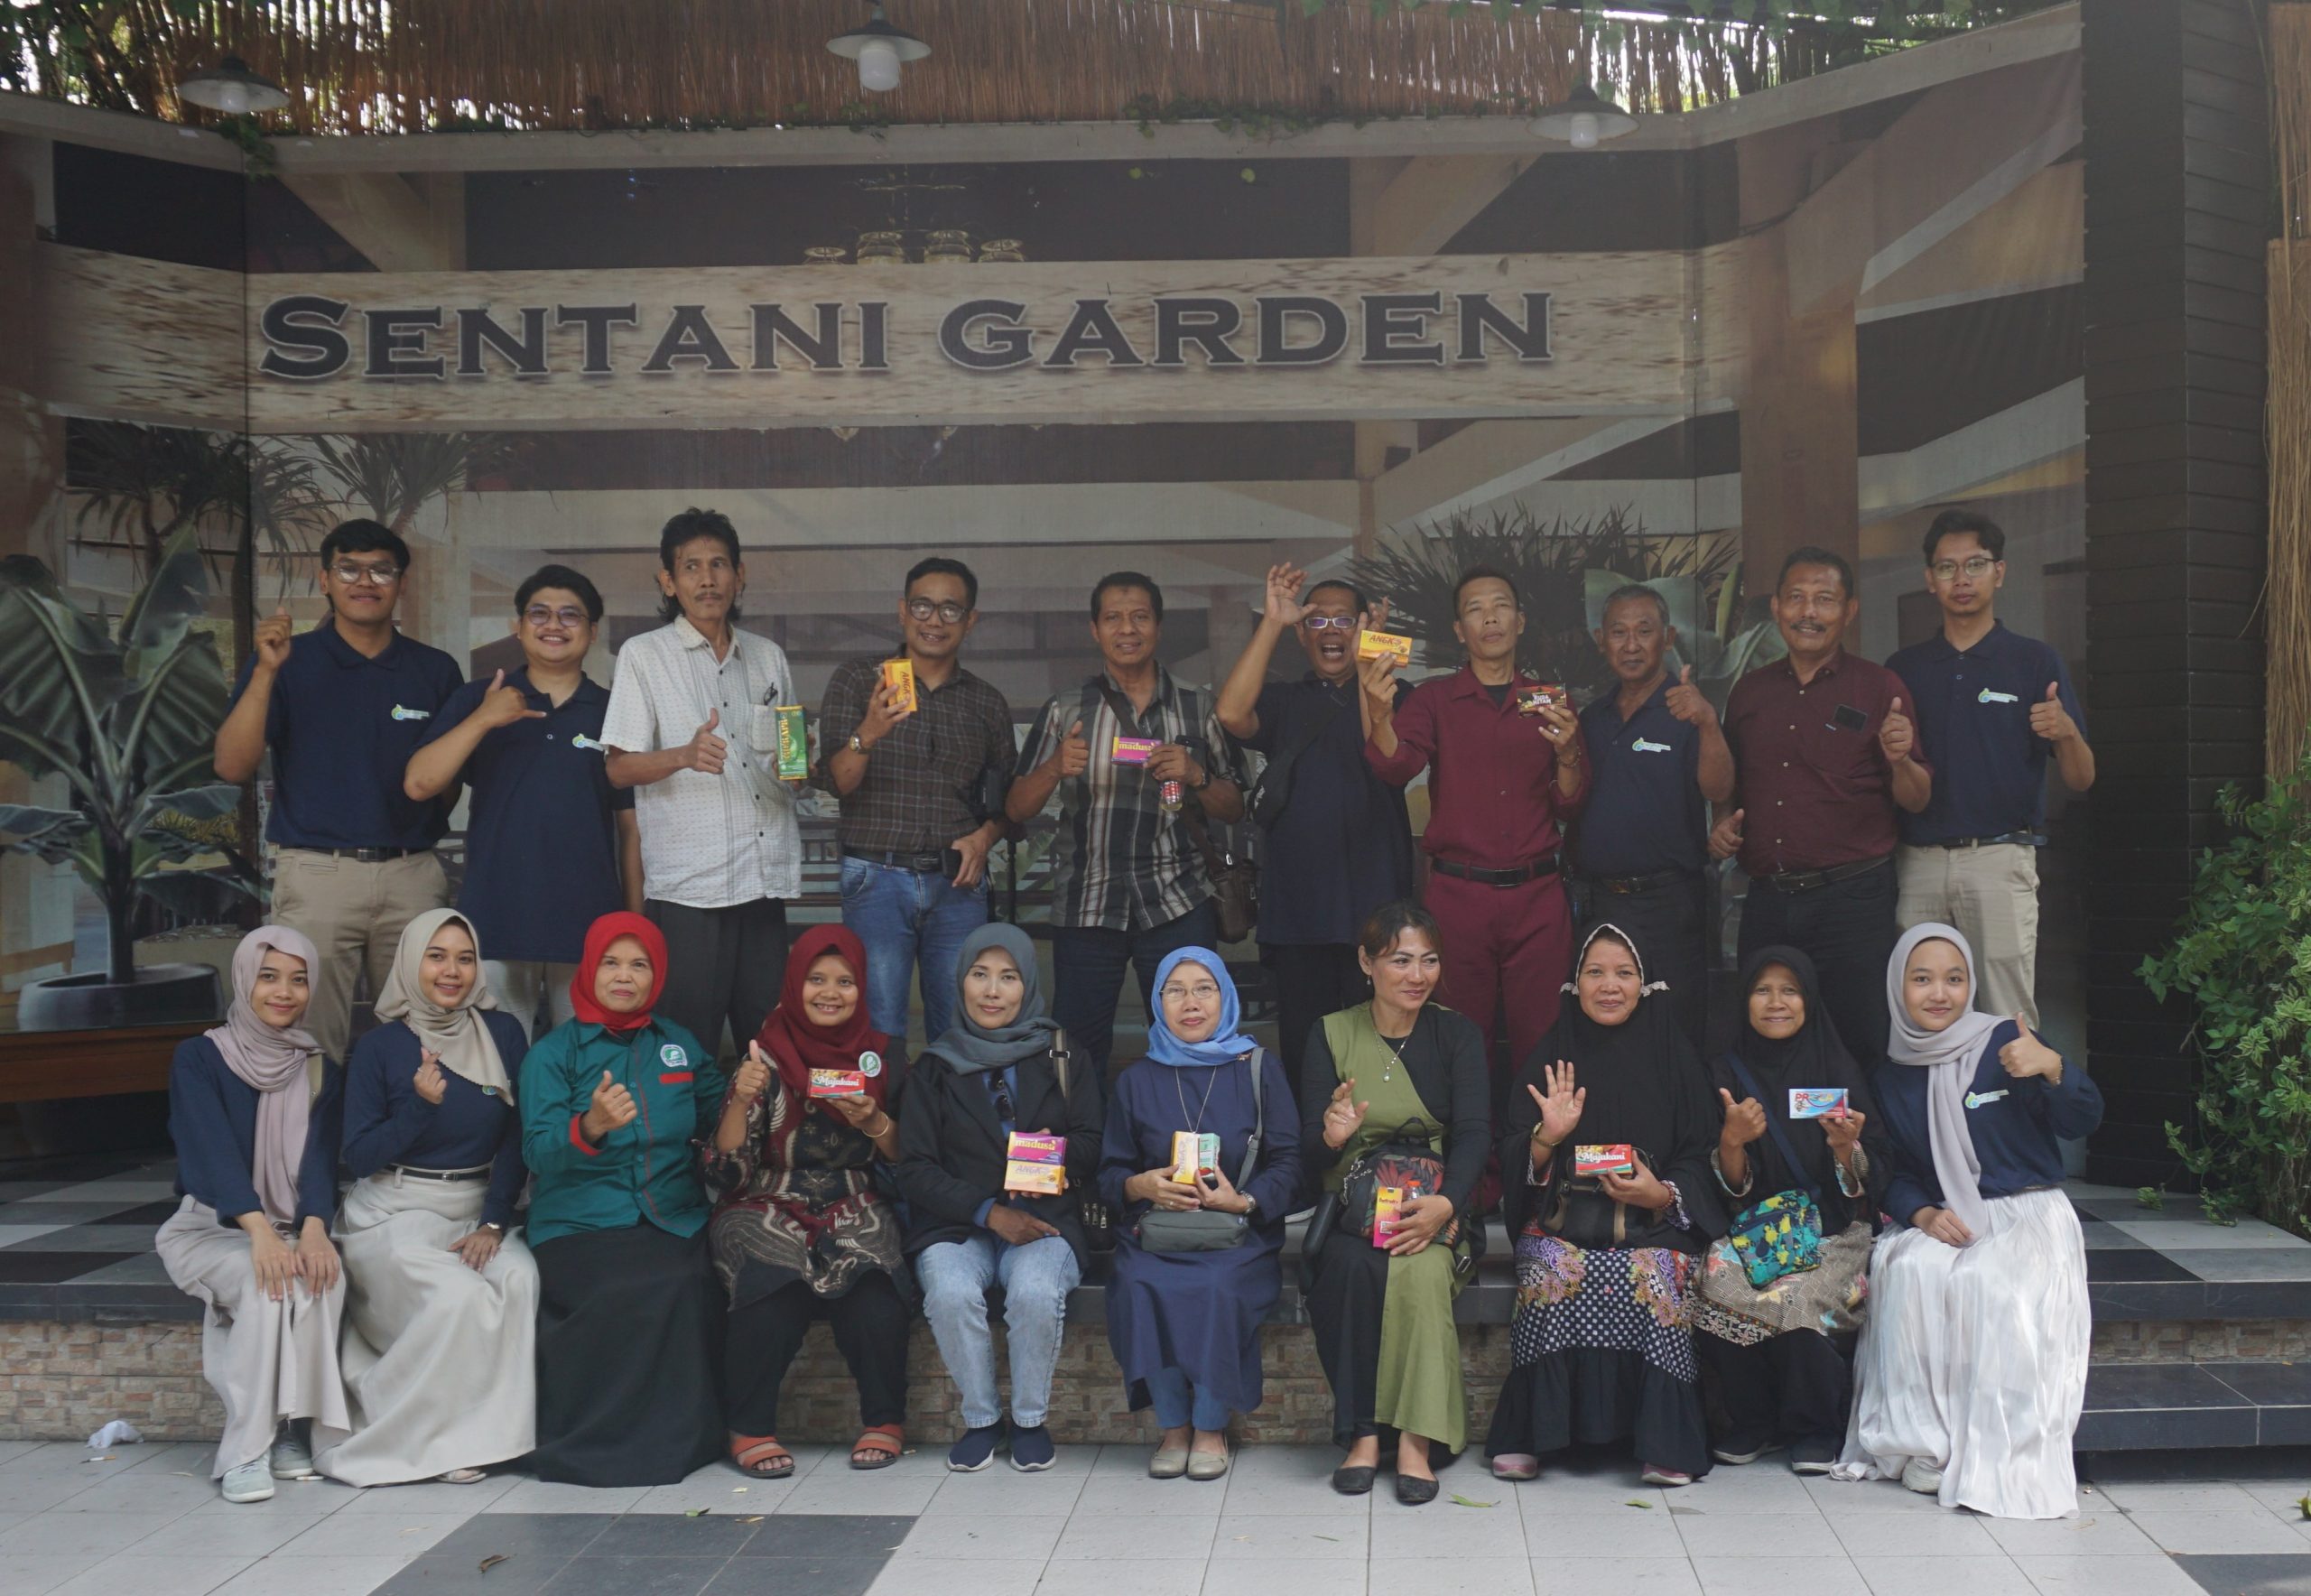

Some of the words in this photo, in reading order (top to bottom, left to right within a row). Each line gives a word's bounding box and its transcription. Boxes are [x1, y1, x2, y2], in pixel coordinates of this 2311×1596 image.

[258, 294, 889, 380] SENTANI
[938, 289, 1555, 370] GARDEN
[1582, 1152, 1626, 1164] Majakani
